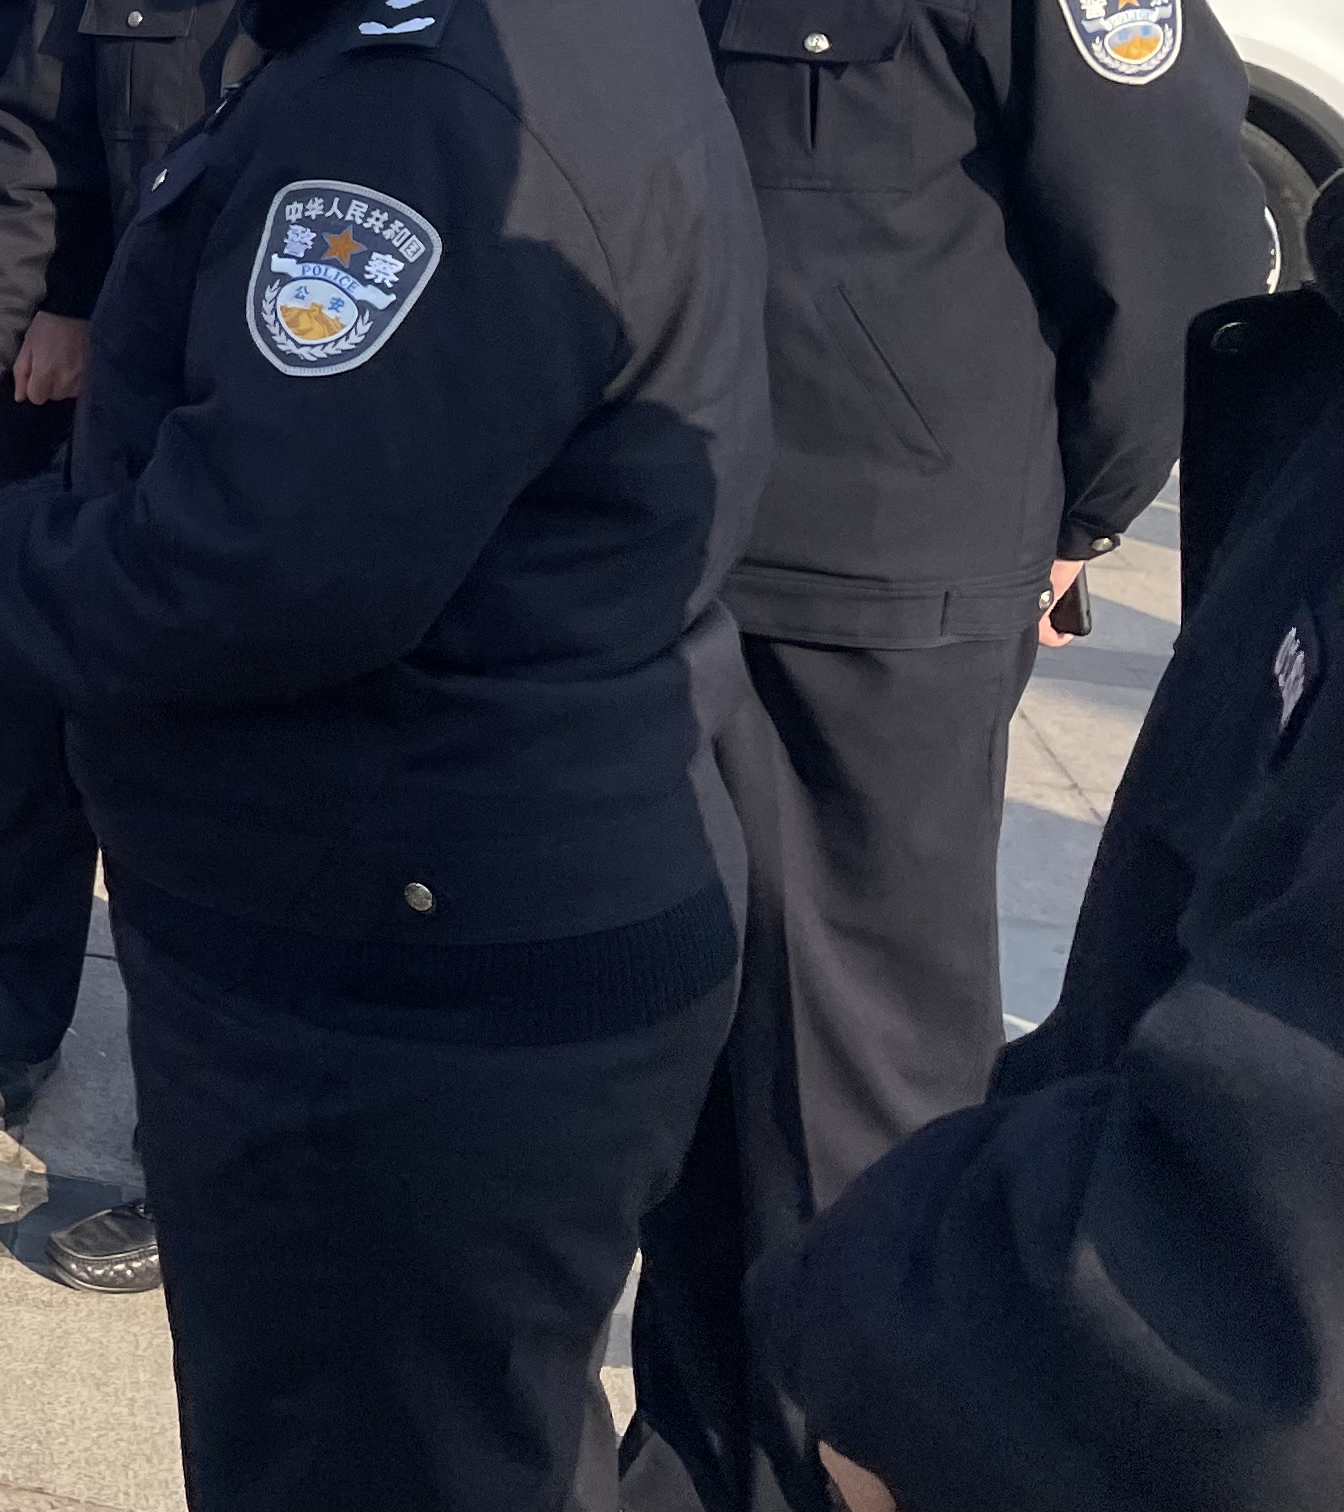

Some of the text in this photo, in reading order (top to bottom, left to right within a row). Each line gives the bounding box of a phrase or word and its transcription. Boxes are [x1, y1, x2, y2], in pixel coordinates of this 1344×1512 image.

[283, 224, 405, 288] 警 察
[285, 196, 426, 263] 中华人民共和国
[301, 264, 357, 294] POLICE
